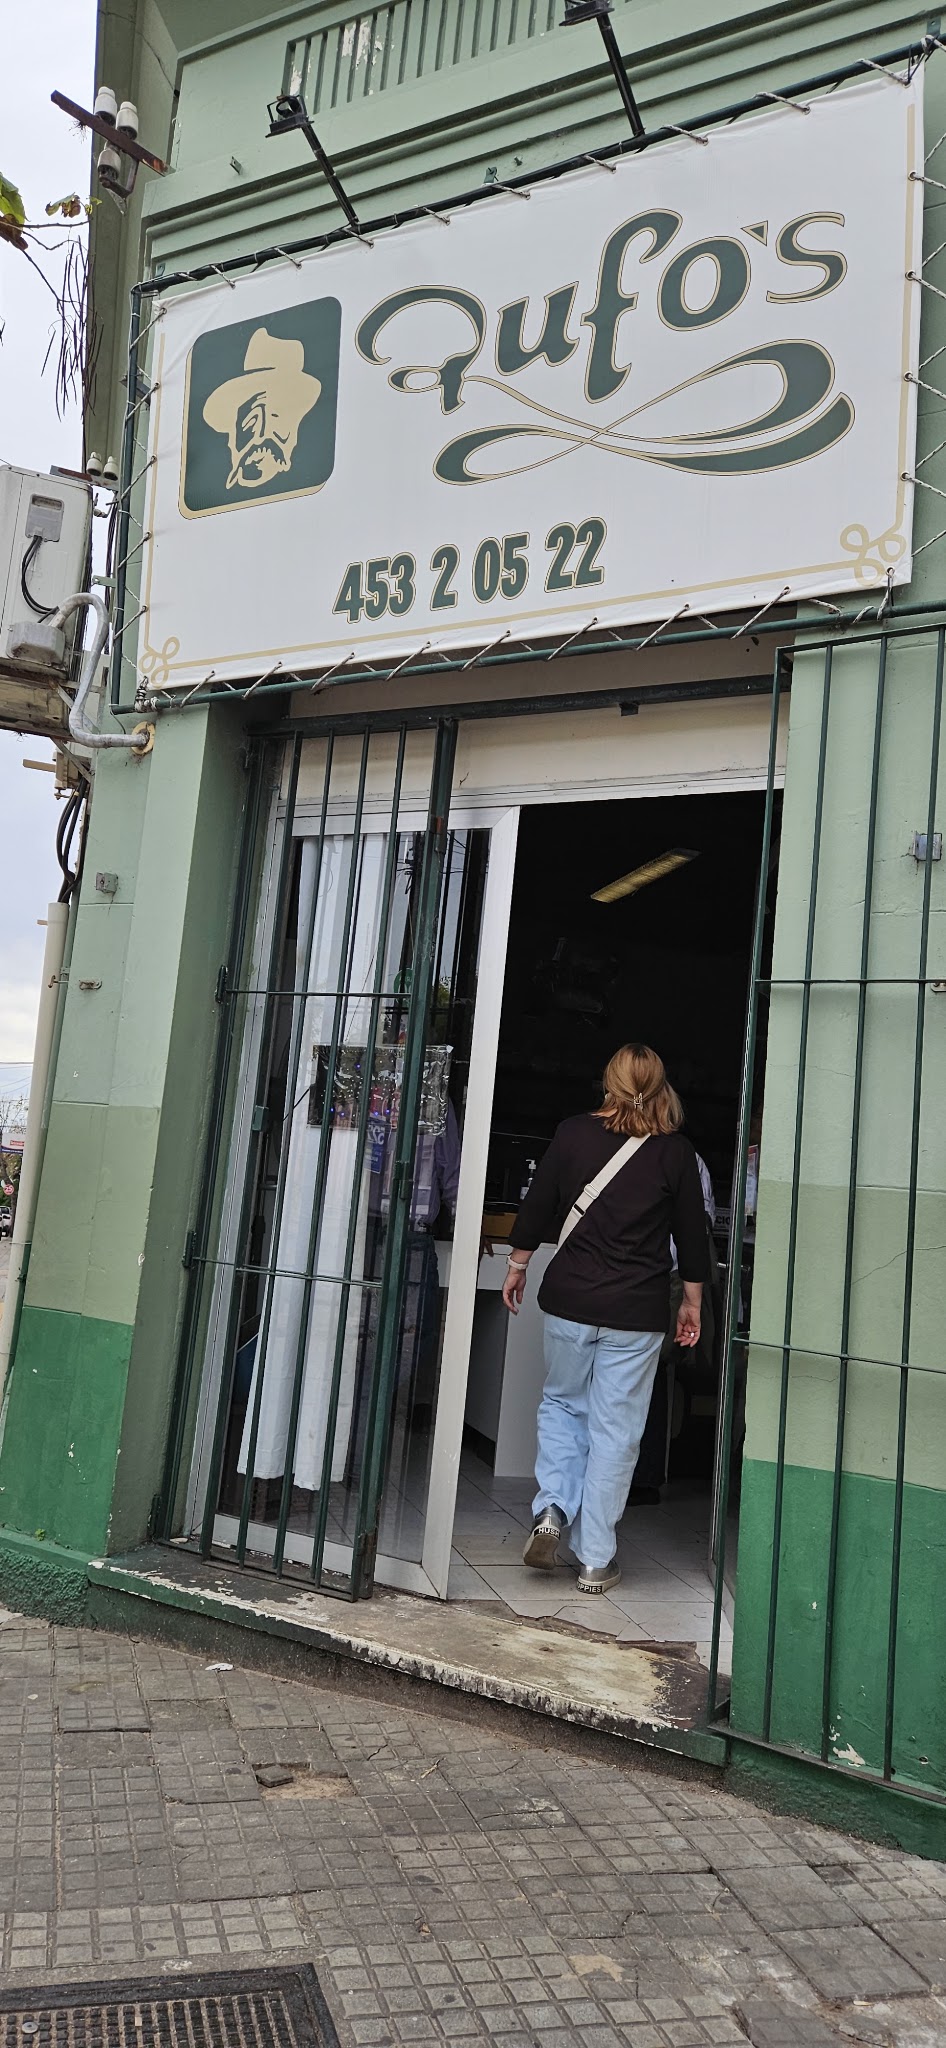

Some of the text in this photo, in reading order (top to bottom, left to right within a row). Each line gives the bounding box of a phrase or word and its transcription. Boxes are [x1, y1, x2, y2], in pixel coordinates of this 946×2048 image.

[332, 517, 607, 624] 453 2 05 22
[538, 1527, 560, 1538] HUSH
[577, 1581, 602, 1593] UPPIES
